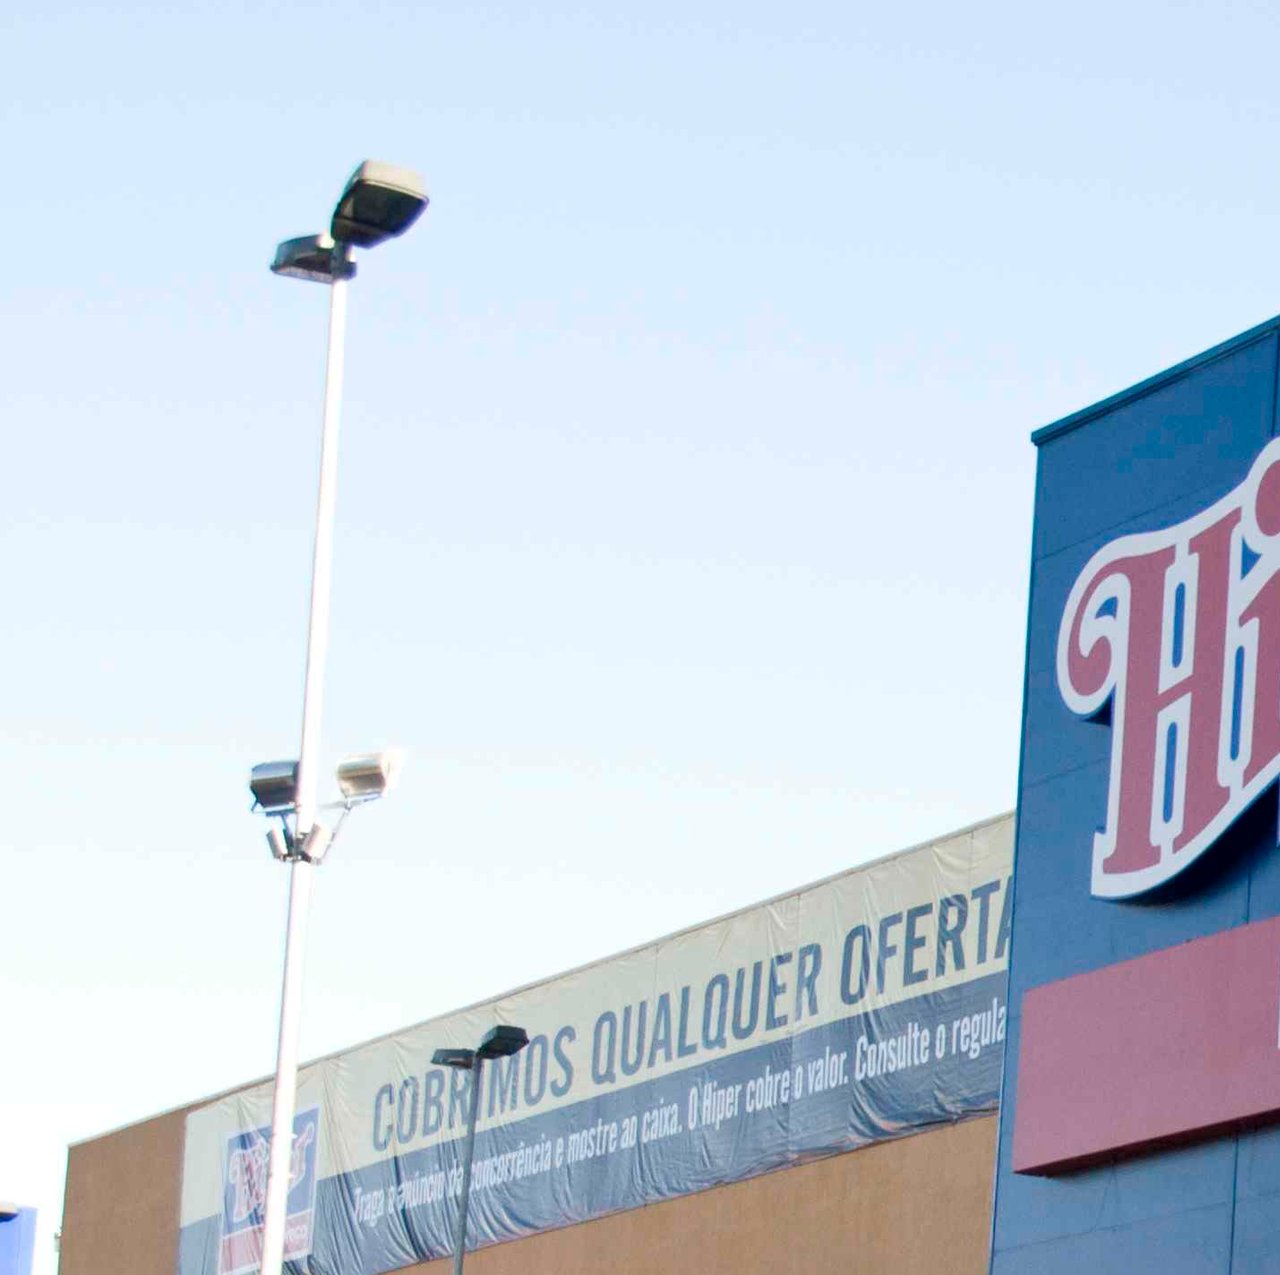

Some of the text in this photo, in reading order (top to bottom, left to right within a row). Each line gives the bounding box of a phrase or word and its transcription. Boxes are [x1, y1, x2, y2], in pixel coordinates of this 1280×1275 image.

[353, 1186, 386, 1228] Traga
[471, 1132, 552, 1192] concorrência
[554, 1139, 564, 1169] e
[567, 1115, 618, 1165] mostre
[621, 1116, 638, 1148] ao
[641, 1098, 683, 1142] caixa.
[688, 1086, 699, 1131] O
[702, 1077, 743, 1132] Hiper
[746, 1065, 790, 1112] cobre
[794, 1064, 803, 1097] o
[808, 1046, 849, 1095] valor.
[854, 1022, 930, 1082] Consulte
[935, 1024, 946, 1060] o
[373, 1025, 577, 1151] COBRMOS
[591, 942, 823, 1085] QUALQUER
